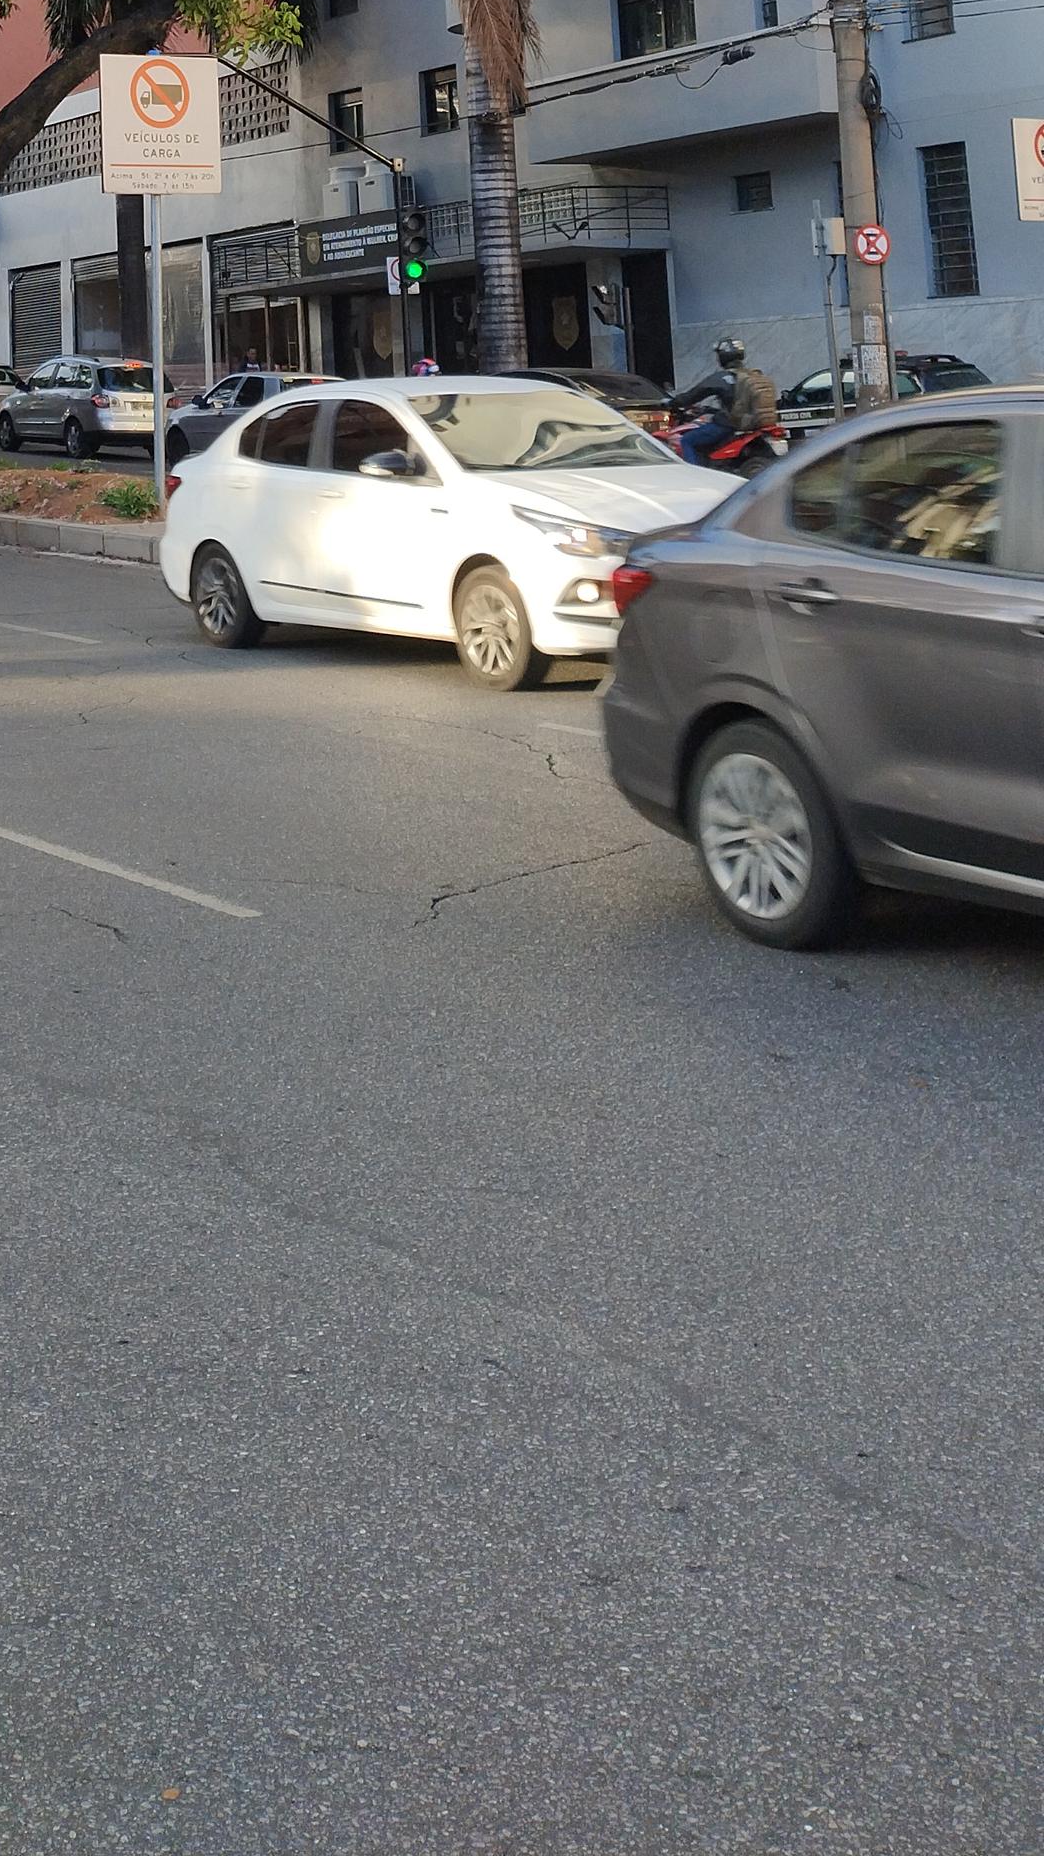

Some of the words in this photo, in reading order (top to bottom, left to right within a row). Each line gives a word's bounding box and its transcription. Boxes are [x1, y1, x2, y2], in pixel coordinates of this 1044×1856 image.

[124, 130, 181, 143] VEÍCULOS
[185, 134, 200, 144] DE
[142, 148, 180, 158] CARGA
